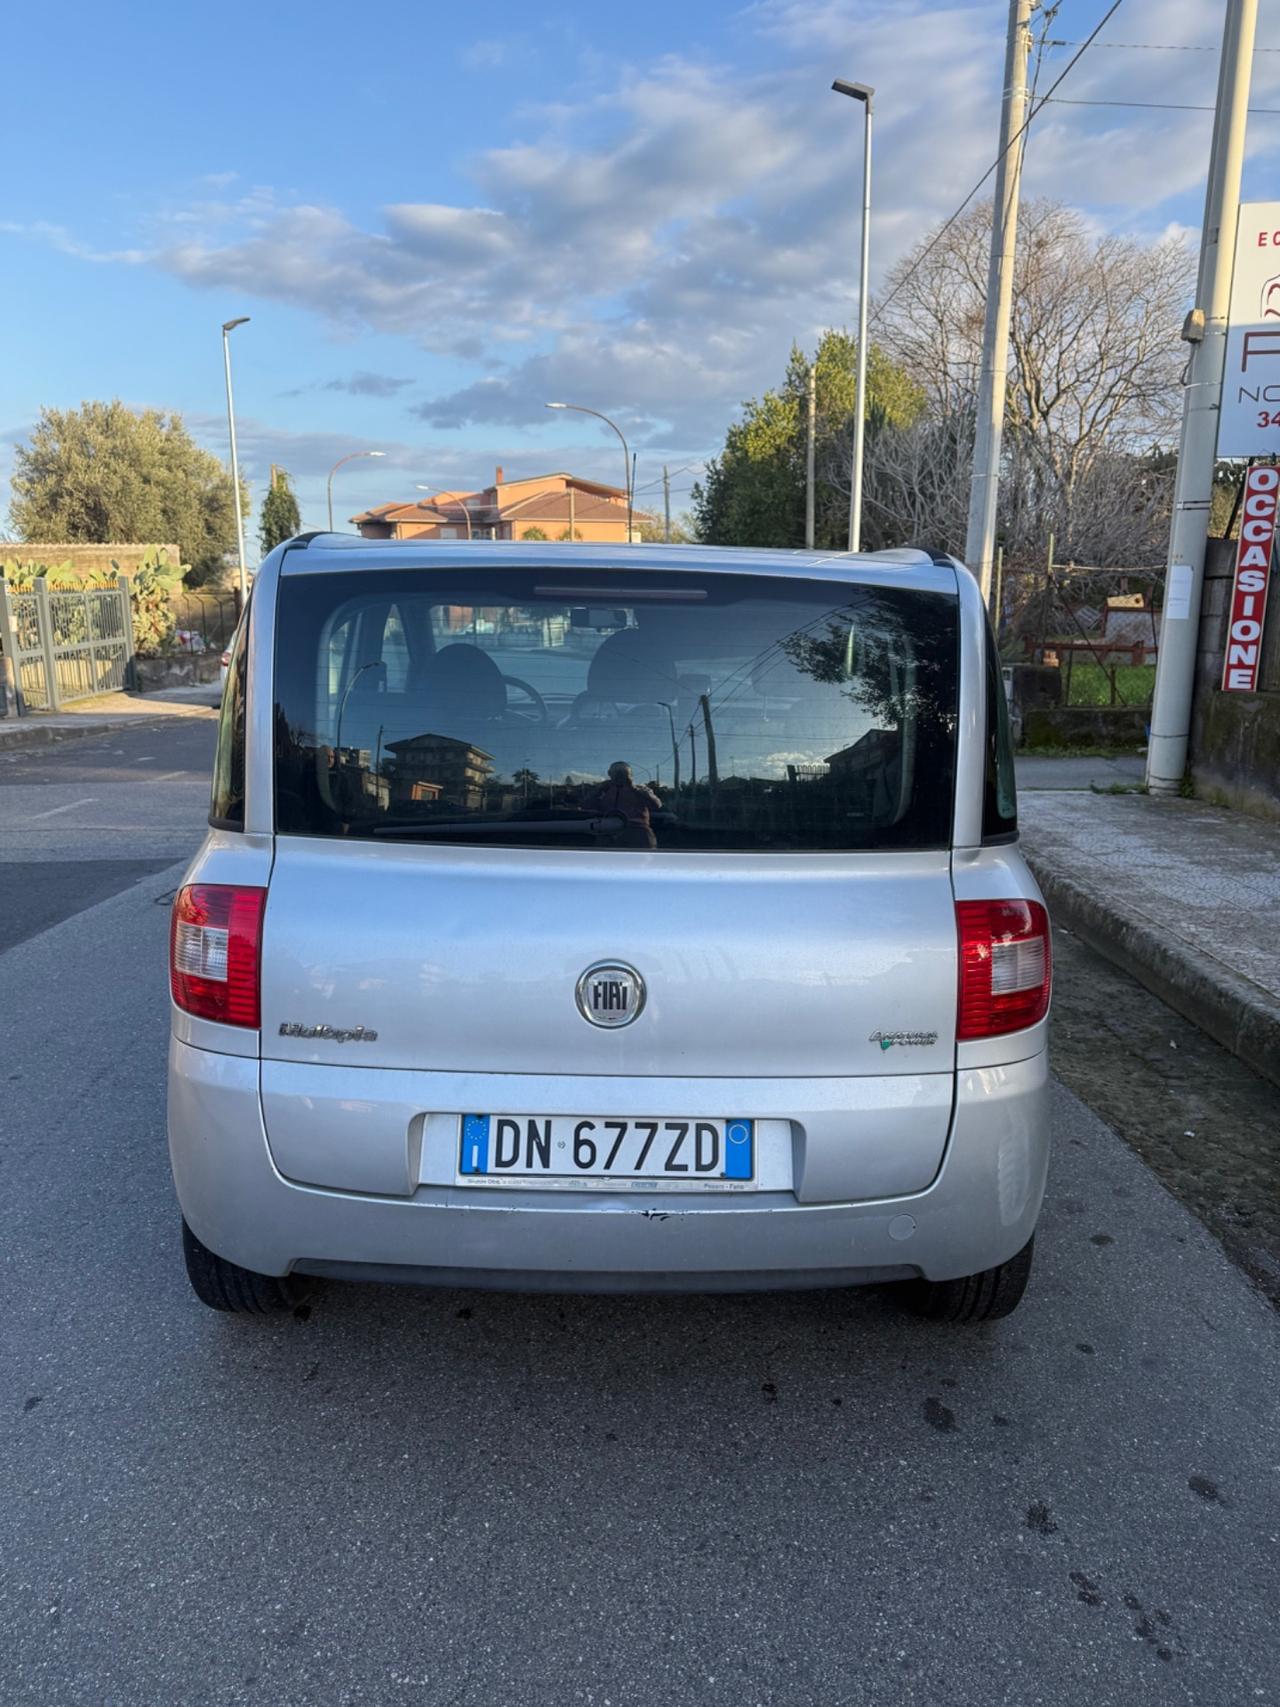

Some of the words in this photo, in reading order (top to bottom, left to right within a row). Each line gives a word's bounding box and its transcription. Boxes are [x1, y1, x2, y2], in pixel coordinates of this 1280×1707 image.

[1228, 468, 1280, 689] OCCASIONE
[593, 981, 628, 1010] FIAT
[495, 1119, 552, 1169] DN
[573, 1120, 720, 1172] 677ZD
